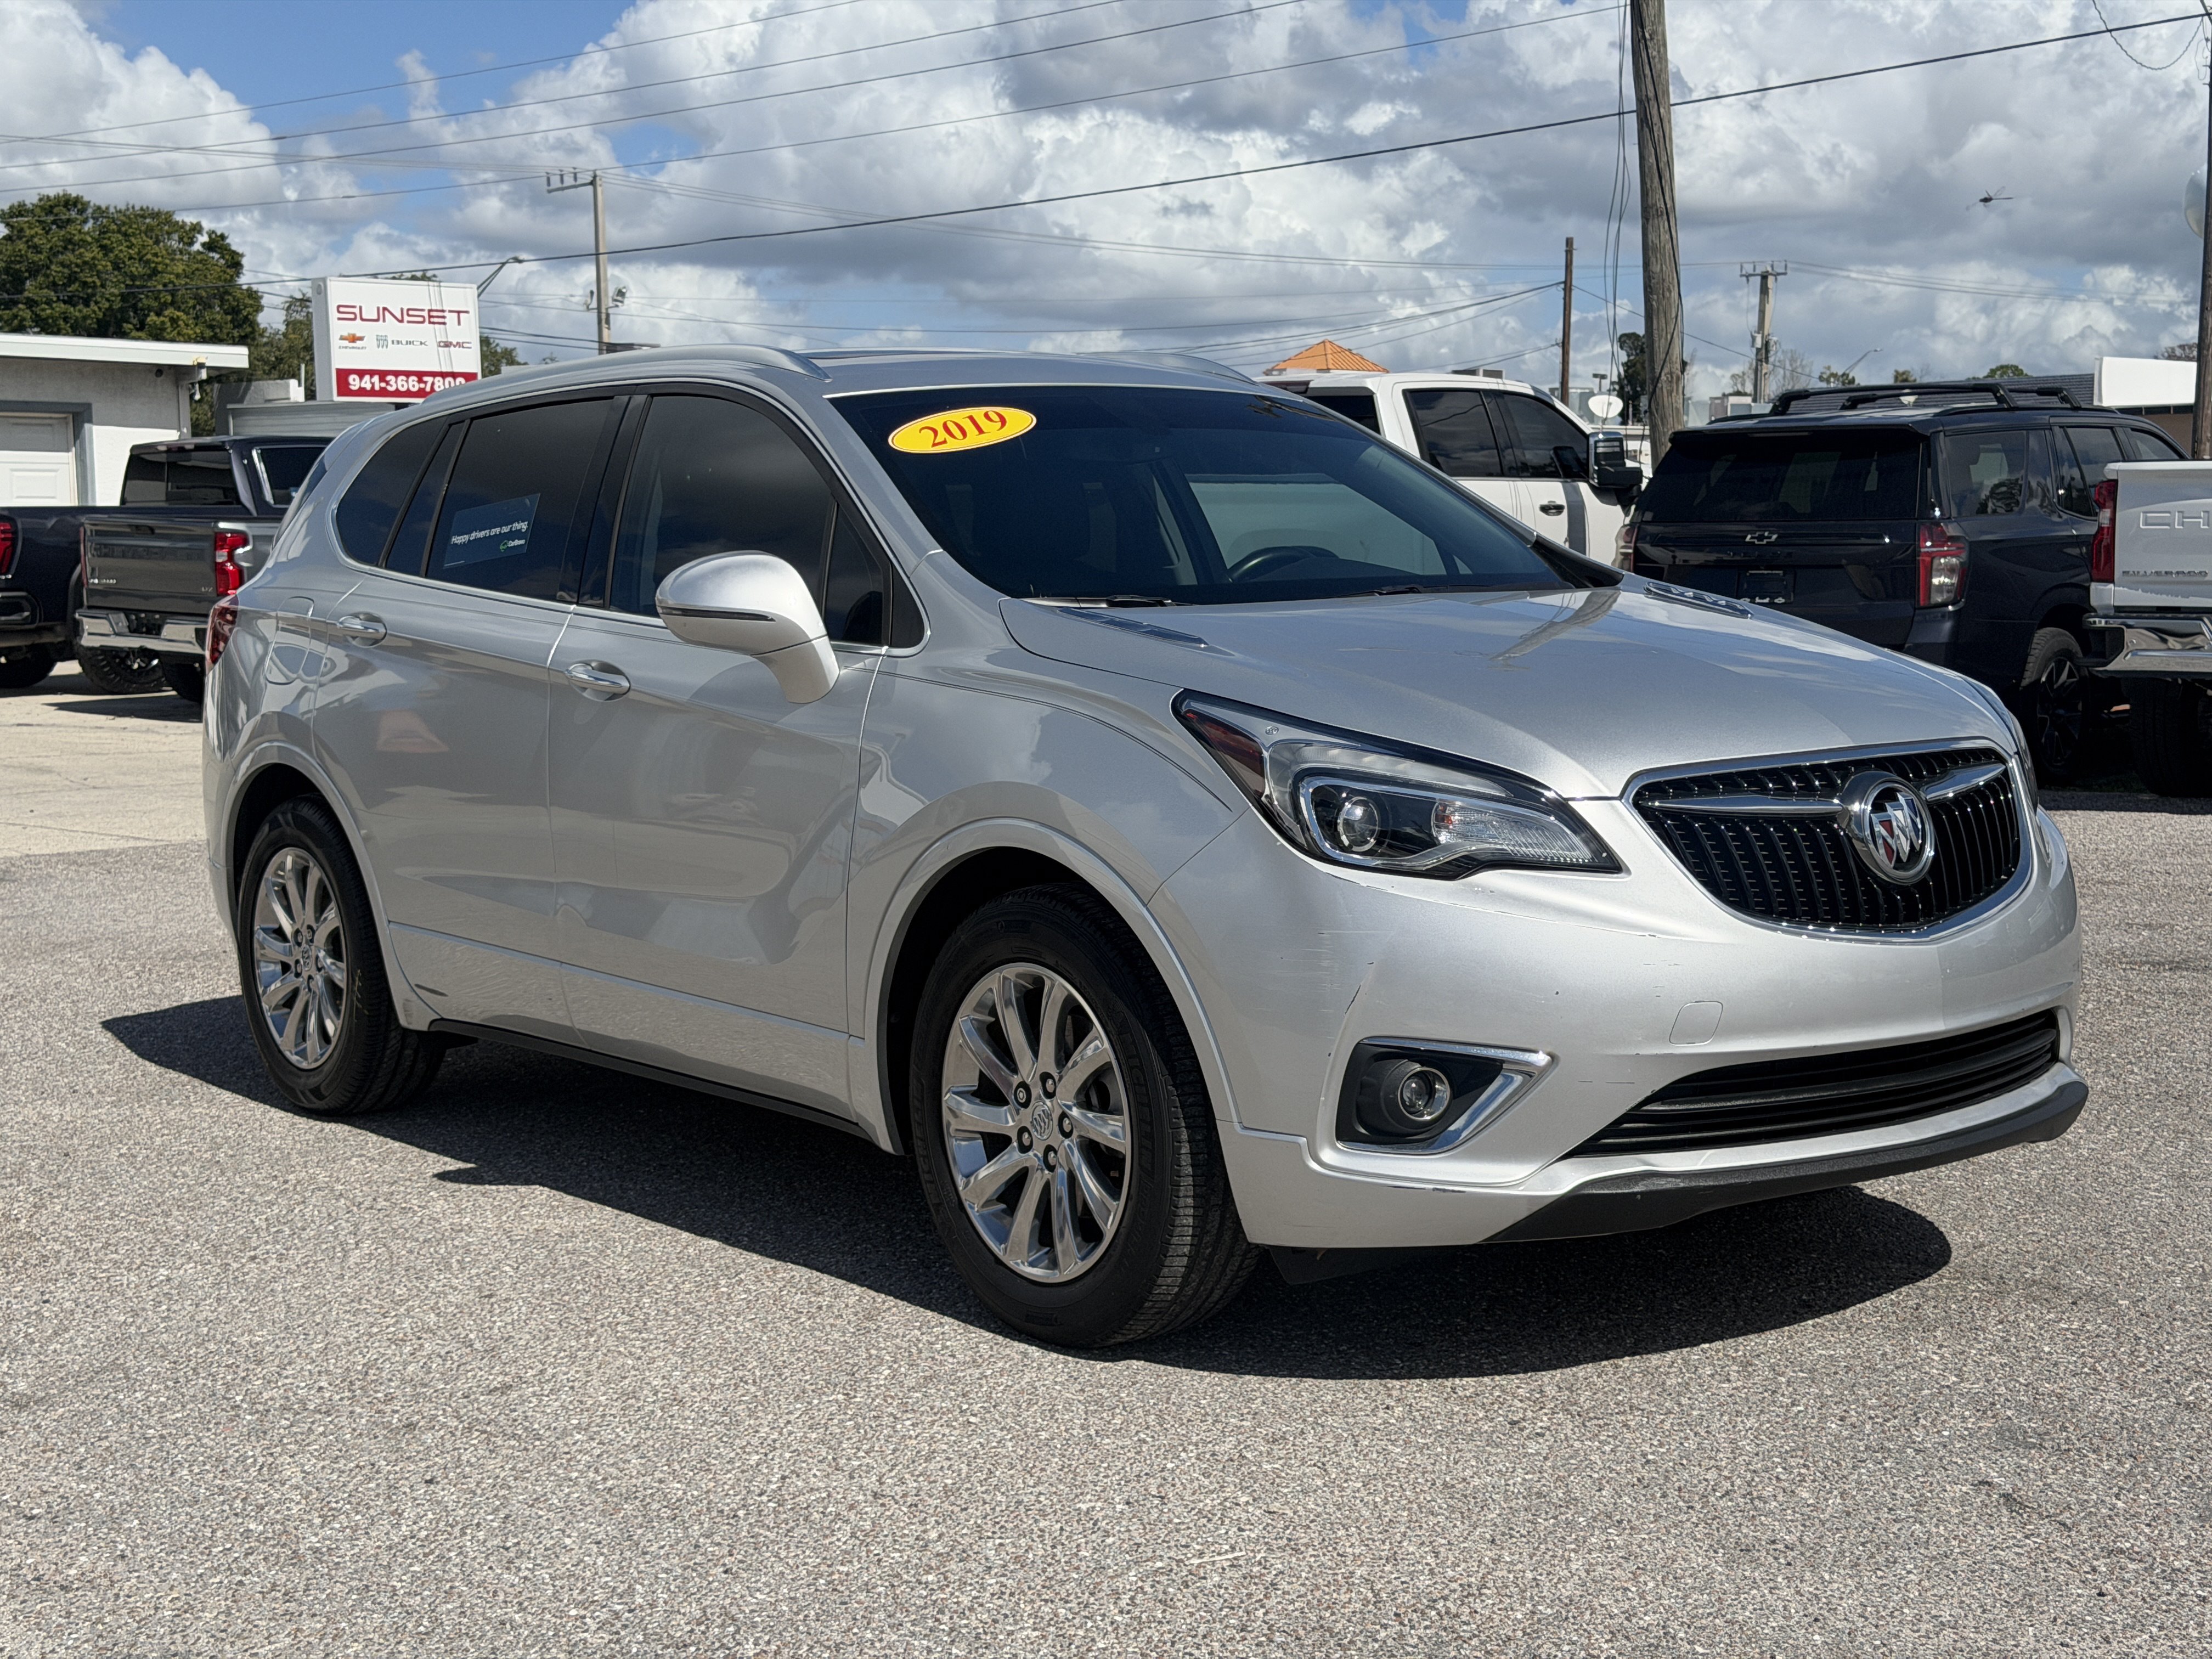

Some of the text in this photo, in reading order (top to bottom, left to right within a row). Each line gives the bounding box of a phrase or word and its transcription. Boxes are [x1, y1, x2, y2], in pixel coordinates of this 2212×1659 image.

[336, 304, 470, 326] SUNSET
[438, 340, 472, 349] GMC
[918, 410, 1007, 448] 2019
[451, 534, 471, 545] Happy
[470, 530, 490, 540] drivers
[490, 527, 501, 535] are
[500, 524, 512, 533] our
